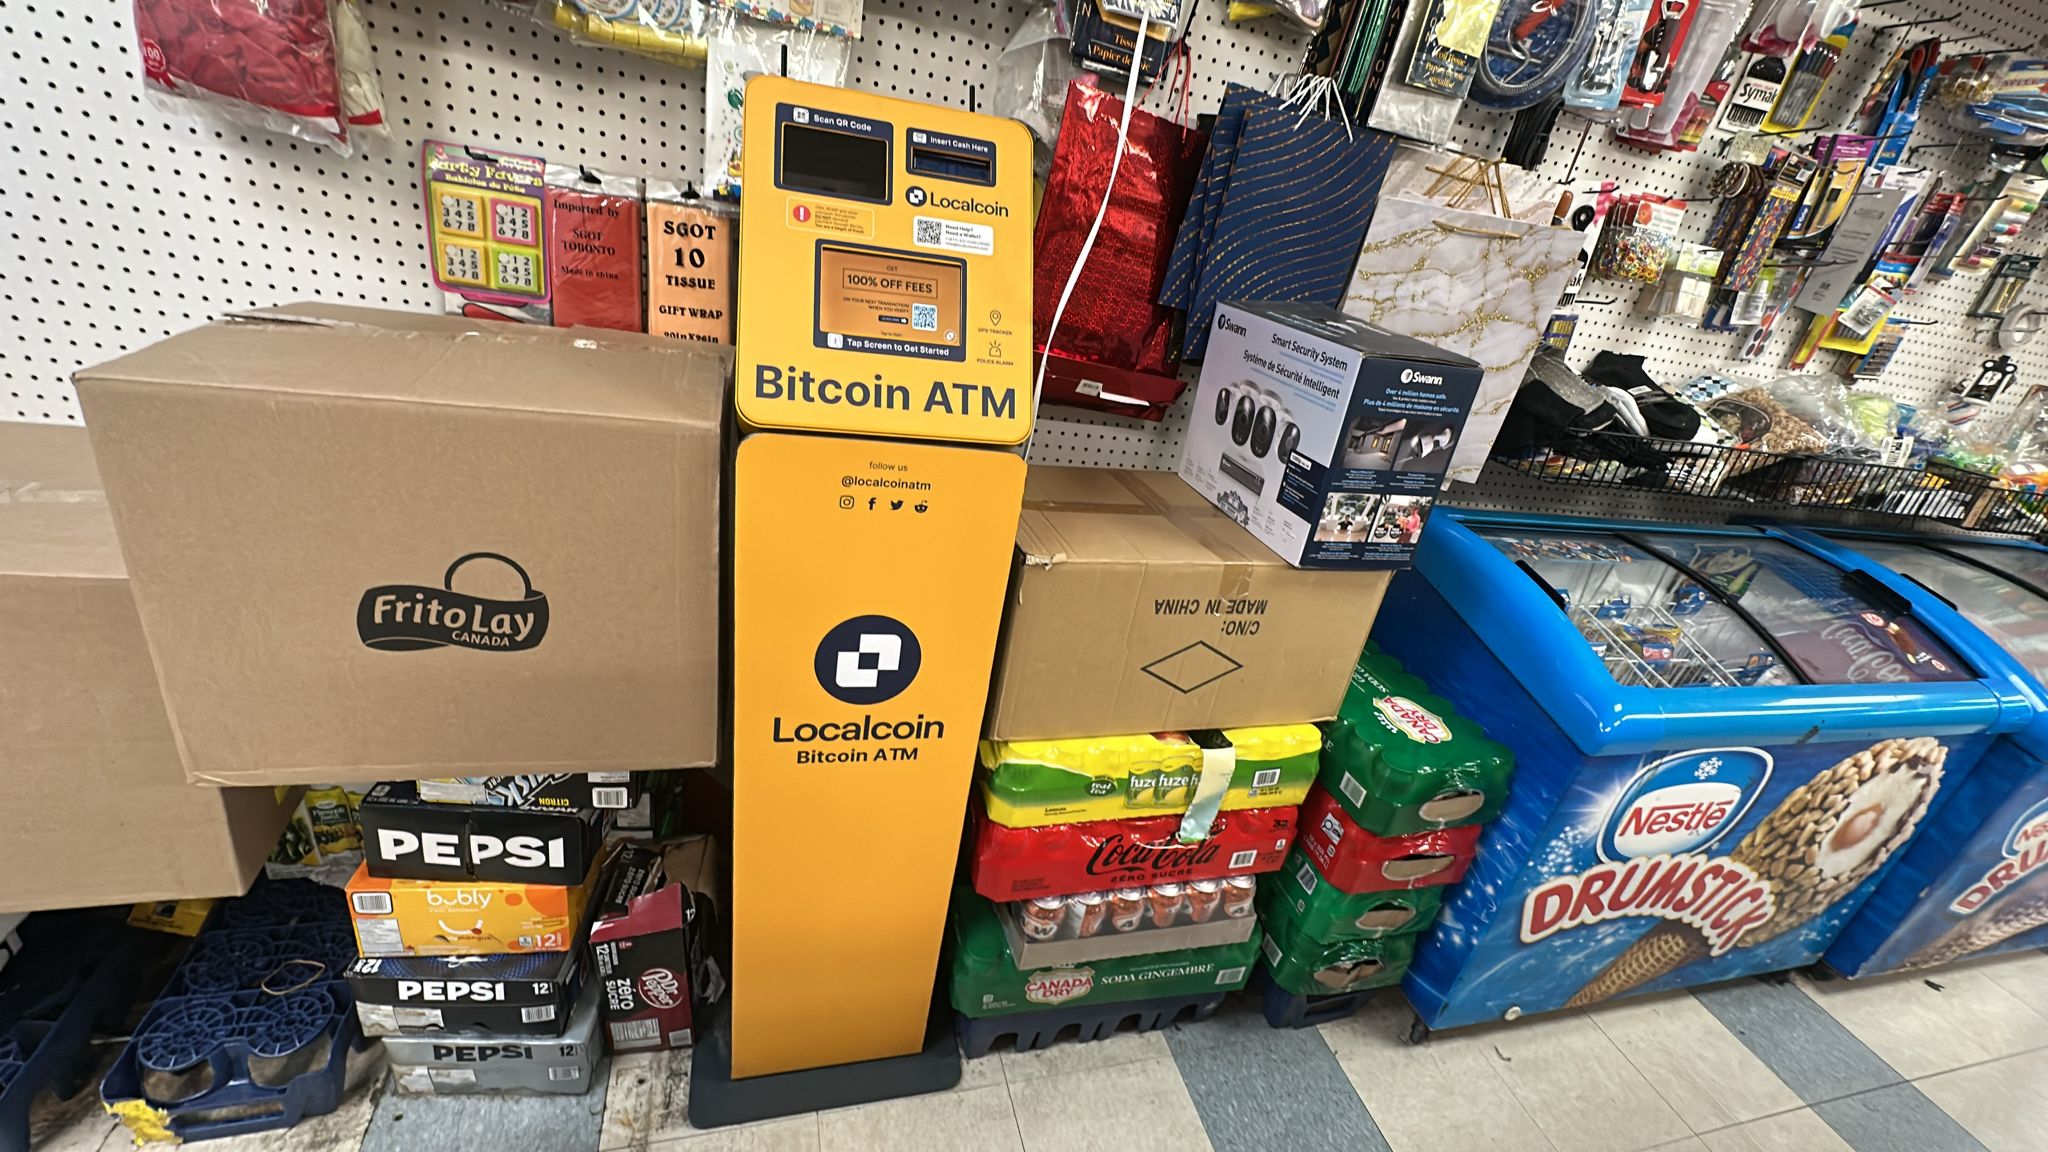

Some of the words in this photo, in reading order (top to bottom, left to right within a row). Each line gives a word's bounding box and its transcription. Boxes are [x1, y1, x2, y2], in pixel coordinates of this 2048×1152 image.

[1093, 44, 1121, 63] Papier
[1122, 55, 1131, 65] de
[813, 113, 835, 126] Scan
[836, 116, 849, 128] QR
[850, 119, 872, 132] Code
[930, 135, 951, 147] Insert
[951, 138, 971, 150] Cash
[971, 143, 989, 153] Here
[554, 199, 603, 216] Imported
[607, 207, 619, 219] by
[930, 191, 1009, 218] Localcoin
[664, 220, 716, 240] SGOT
[675, 247, 706, 268] 10
[561, 265, 583, 275] Made
[586, 269, 594, 277] in
[596, 271, 619, 280] china
[665, 274, 716, 290] TISSUE
[847, 274, 878, 288] 100%
[880, 276, 904, 291] OFF
[905, 281, 933, 294] FEES
[659, 305, 686, 317] GIFT
[688, 308, 723, 320] WRAP
[989, 328, 1012, 336] TRACKER
[1225, 318, 1247, 338] Swann
[847, 338, 862, 350] Tap
[864, 340, 893, 351] Screen
[894, 343, 902, 352] to
[904, 344, 918, 355] Get
[919, 345, 949, 357] Started
[1271, 333, 1290, 350] Smart
[1291, 339, 1320, 362] Security
[1319, 350, 1348, 372] System
[995, 359, 1014, 367] ALARM
[1243, 349, 1266, 370] Système
[1266, 359, 1275, 372] de
[1275, 361, 1303, 383] Sécurité
[1303, 374, 1340, 400] Intelligent
[1412, 371, 1443, 386] Swann
[755, 364, 910, 411] Bitcoin
[923, 381, 1016, 420] ATM
[869, 461, 896, 472] follow
[897, 464, 908, 472] us
[841, 475, 931, 491] @localcoinatm
[1154, 599, 1200, 615] CHINA
[1205, 600, 1222, 615] IN
[1226, 600, 1269, 615] MADE
[1220, 620, 1260, 636] C/NO:
[451, 630, 511, 647] CANADA
[1383, 695, 1439, 743] CANADA
[1405, 707, 1439, 731] DRY
[773, 714, 944, 743] Localcoin
[797, 748, 868, 764] Bitcoin
[873, 748, 918, 761] ATM
[1158, 774, 1188, 787] fuze
[539, 797, 569, 807] CITRON
[1619, 797, 1738, 837] Nestlé
[377, 828, 565, 868] PEPSI
[1530, 857, 1769, 949] DRUMSTICK
[534, 934, 557, 947] 12
[1101, 973, 1136, 985] SODA
[1139, 963, 1215, 981] GINGEMBRE
[397, 980, 506, 1001] PEPSI
[532, 983, 549, 994] 12
[641, 972, 674, 1006] Pepper
[662, 980, 679, 995] Dr
[1026, 977, 1094, 993] CANADA
[1042, 987, 1074, 998] DRY
[605, 980, 619, 1011] SUCRE
[618, 978, 636, 1011] zéro
[433, 1045, 534, 1062] PEPSI
[560, 1045, 575, 1057] 12
